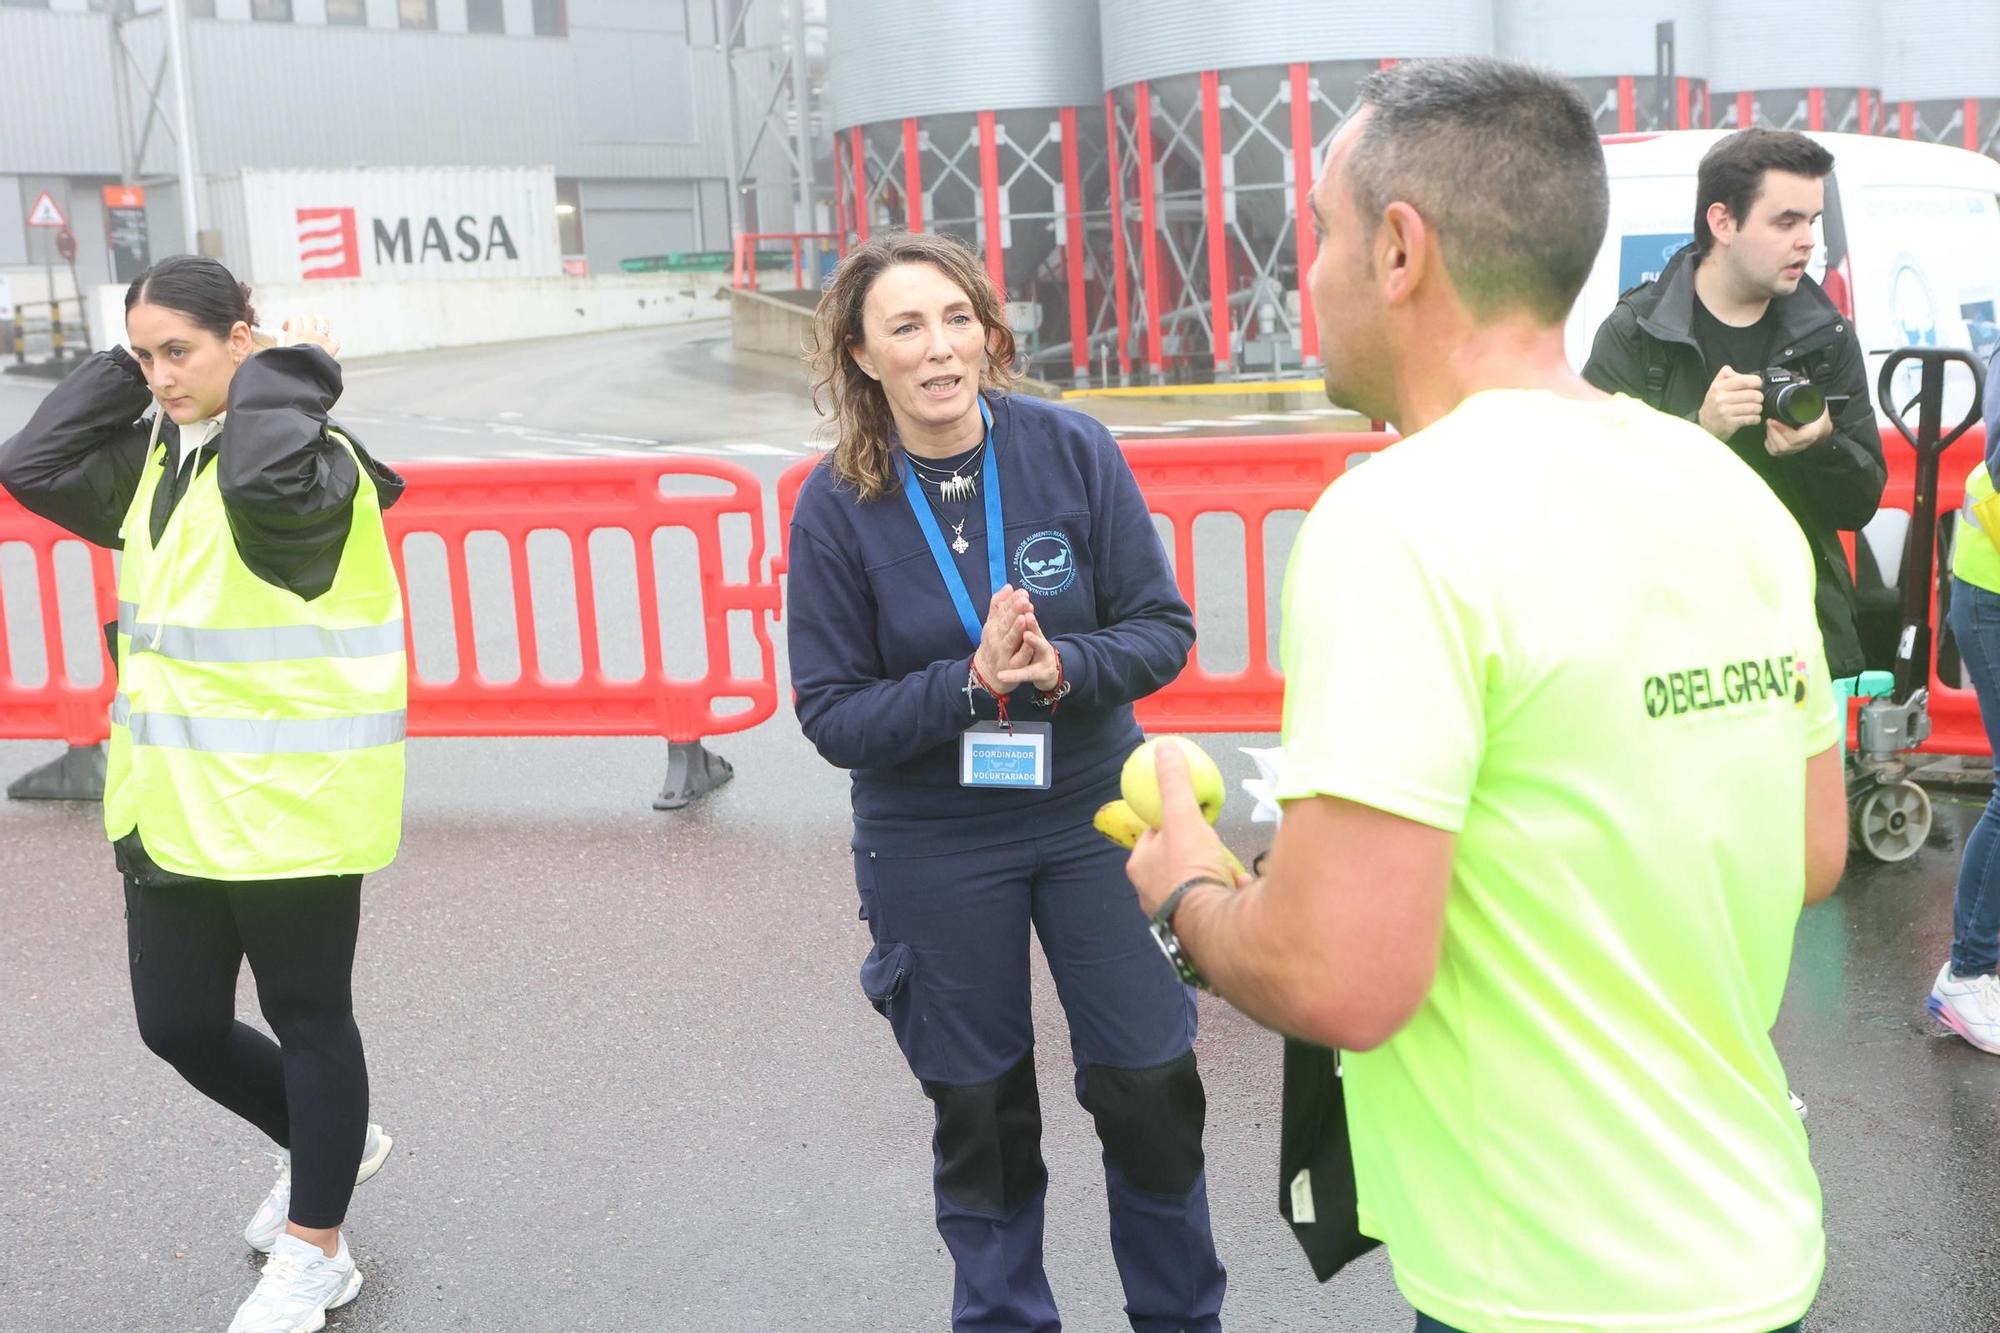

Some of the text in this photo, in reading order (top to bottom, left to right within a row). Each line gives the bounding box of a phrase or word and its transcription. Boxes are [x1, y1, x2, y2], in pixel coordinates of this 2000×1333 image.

[373, 215, 518, 265] MASA
[1020, 578, 1049, 597] PROVINCIA
[972, 750, 1034, 760] COORDINADOR
[973, 771, 1035, 781] VOLUNTARIADO
